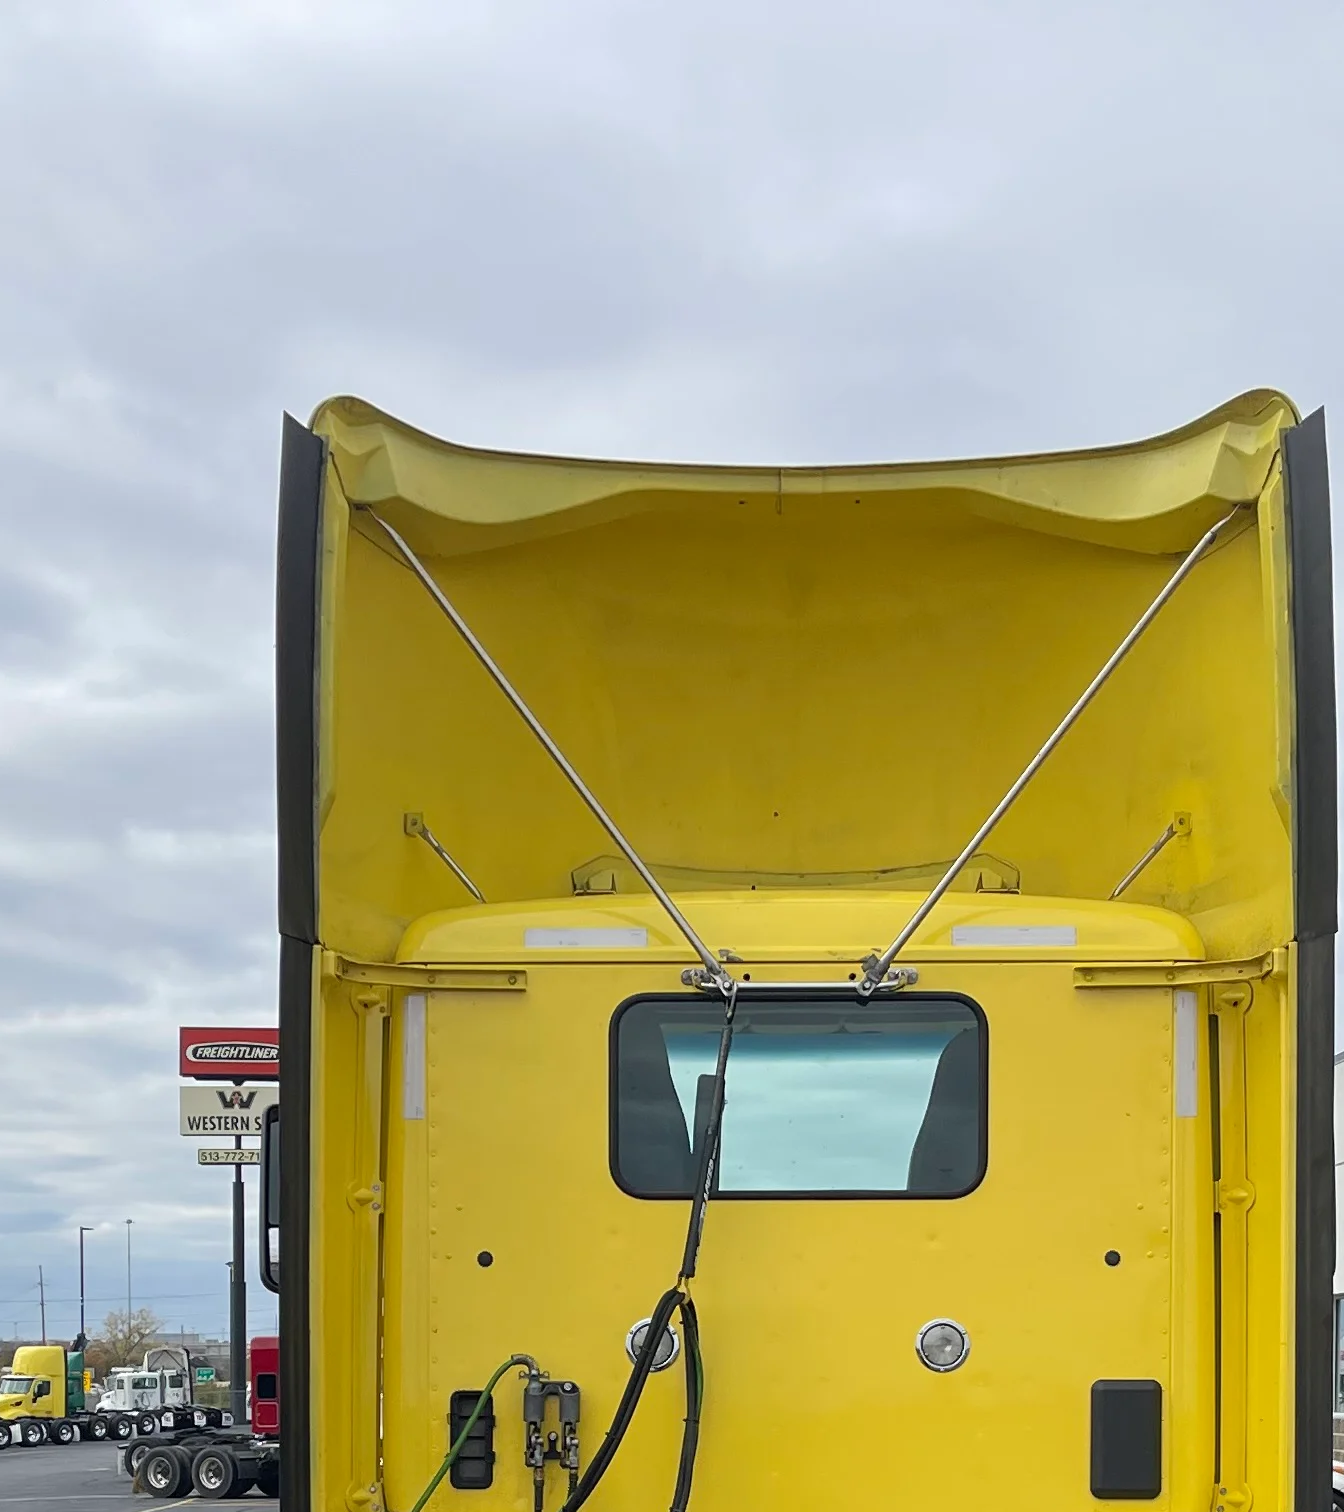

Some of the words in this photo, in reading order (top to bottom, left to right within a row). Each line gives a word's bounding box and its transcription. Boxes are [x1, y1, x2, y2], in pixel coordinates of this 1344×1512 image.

[196, 1046, 278, 1059] FREIGHTLINER
[188, 1116, 250, 1131] WESTERN
[201, 1152, 260, 1161] 513-772-71
